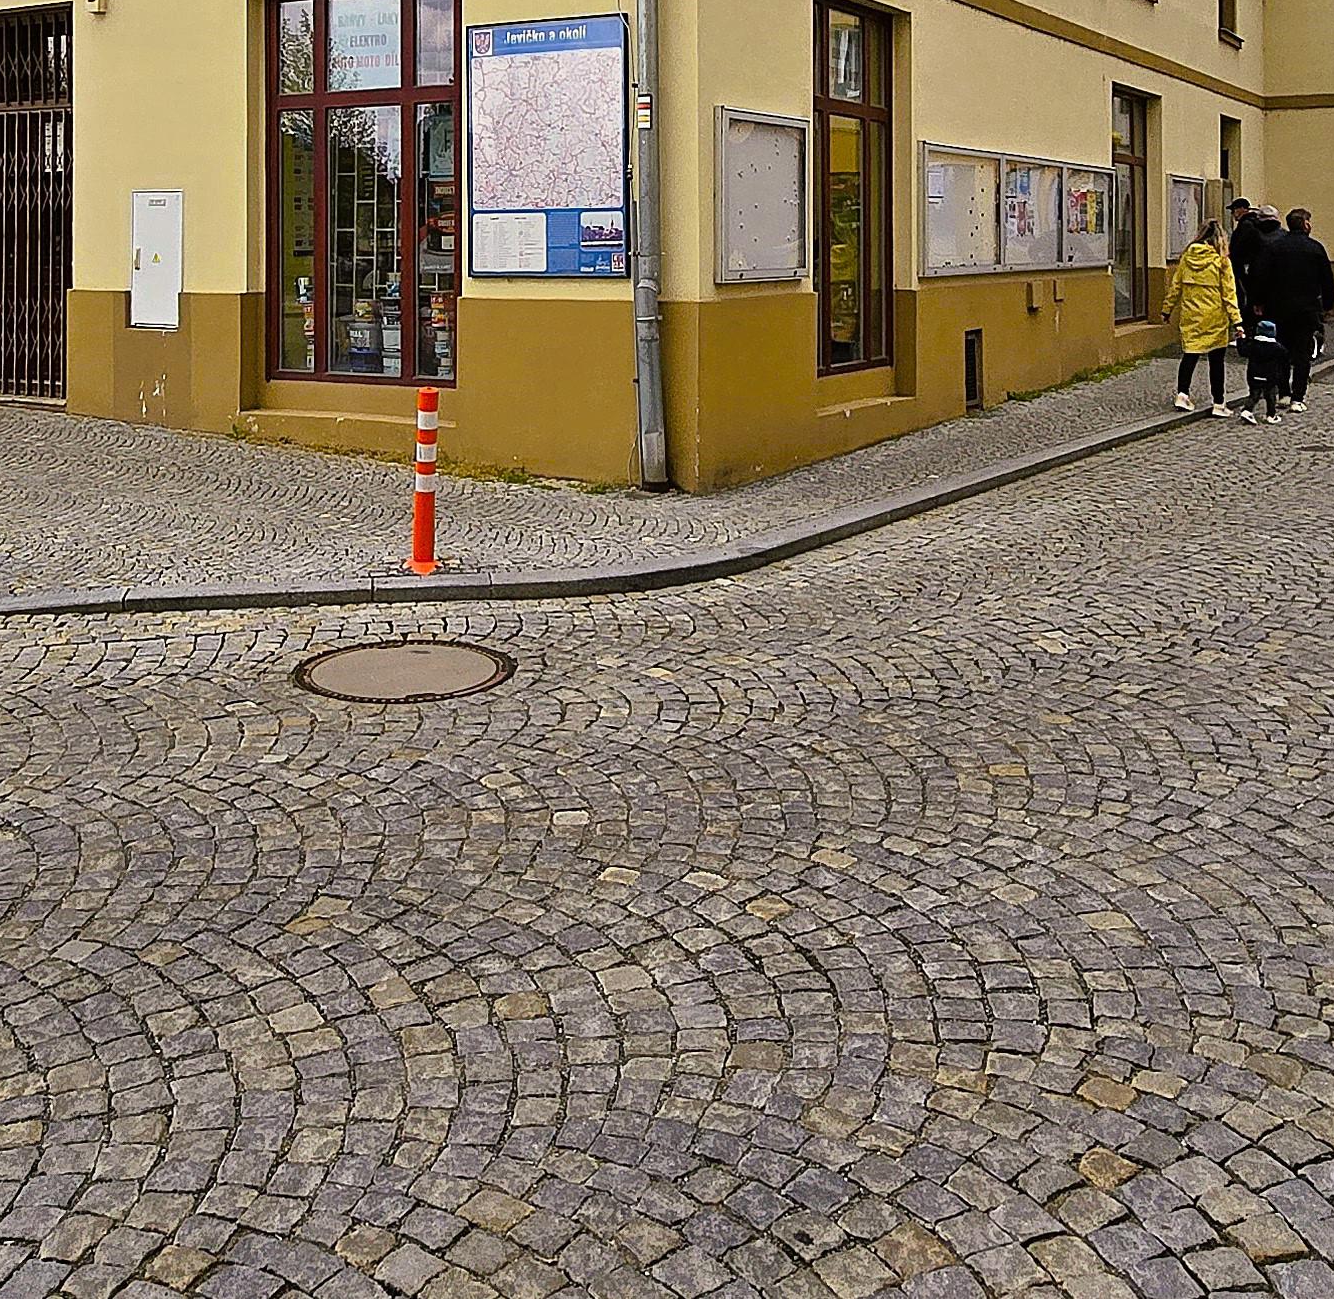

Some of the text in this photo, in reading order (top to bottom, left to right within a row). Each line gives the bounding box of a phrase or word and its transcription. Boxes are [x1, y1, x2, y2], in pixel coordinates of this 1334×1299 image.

[349, 33, 387, 48] ELEKTRO
[503, 25, 587, 45] Jevíčko a okolí
